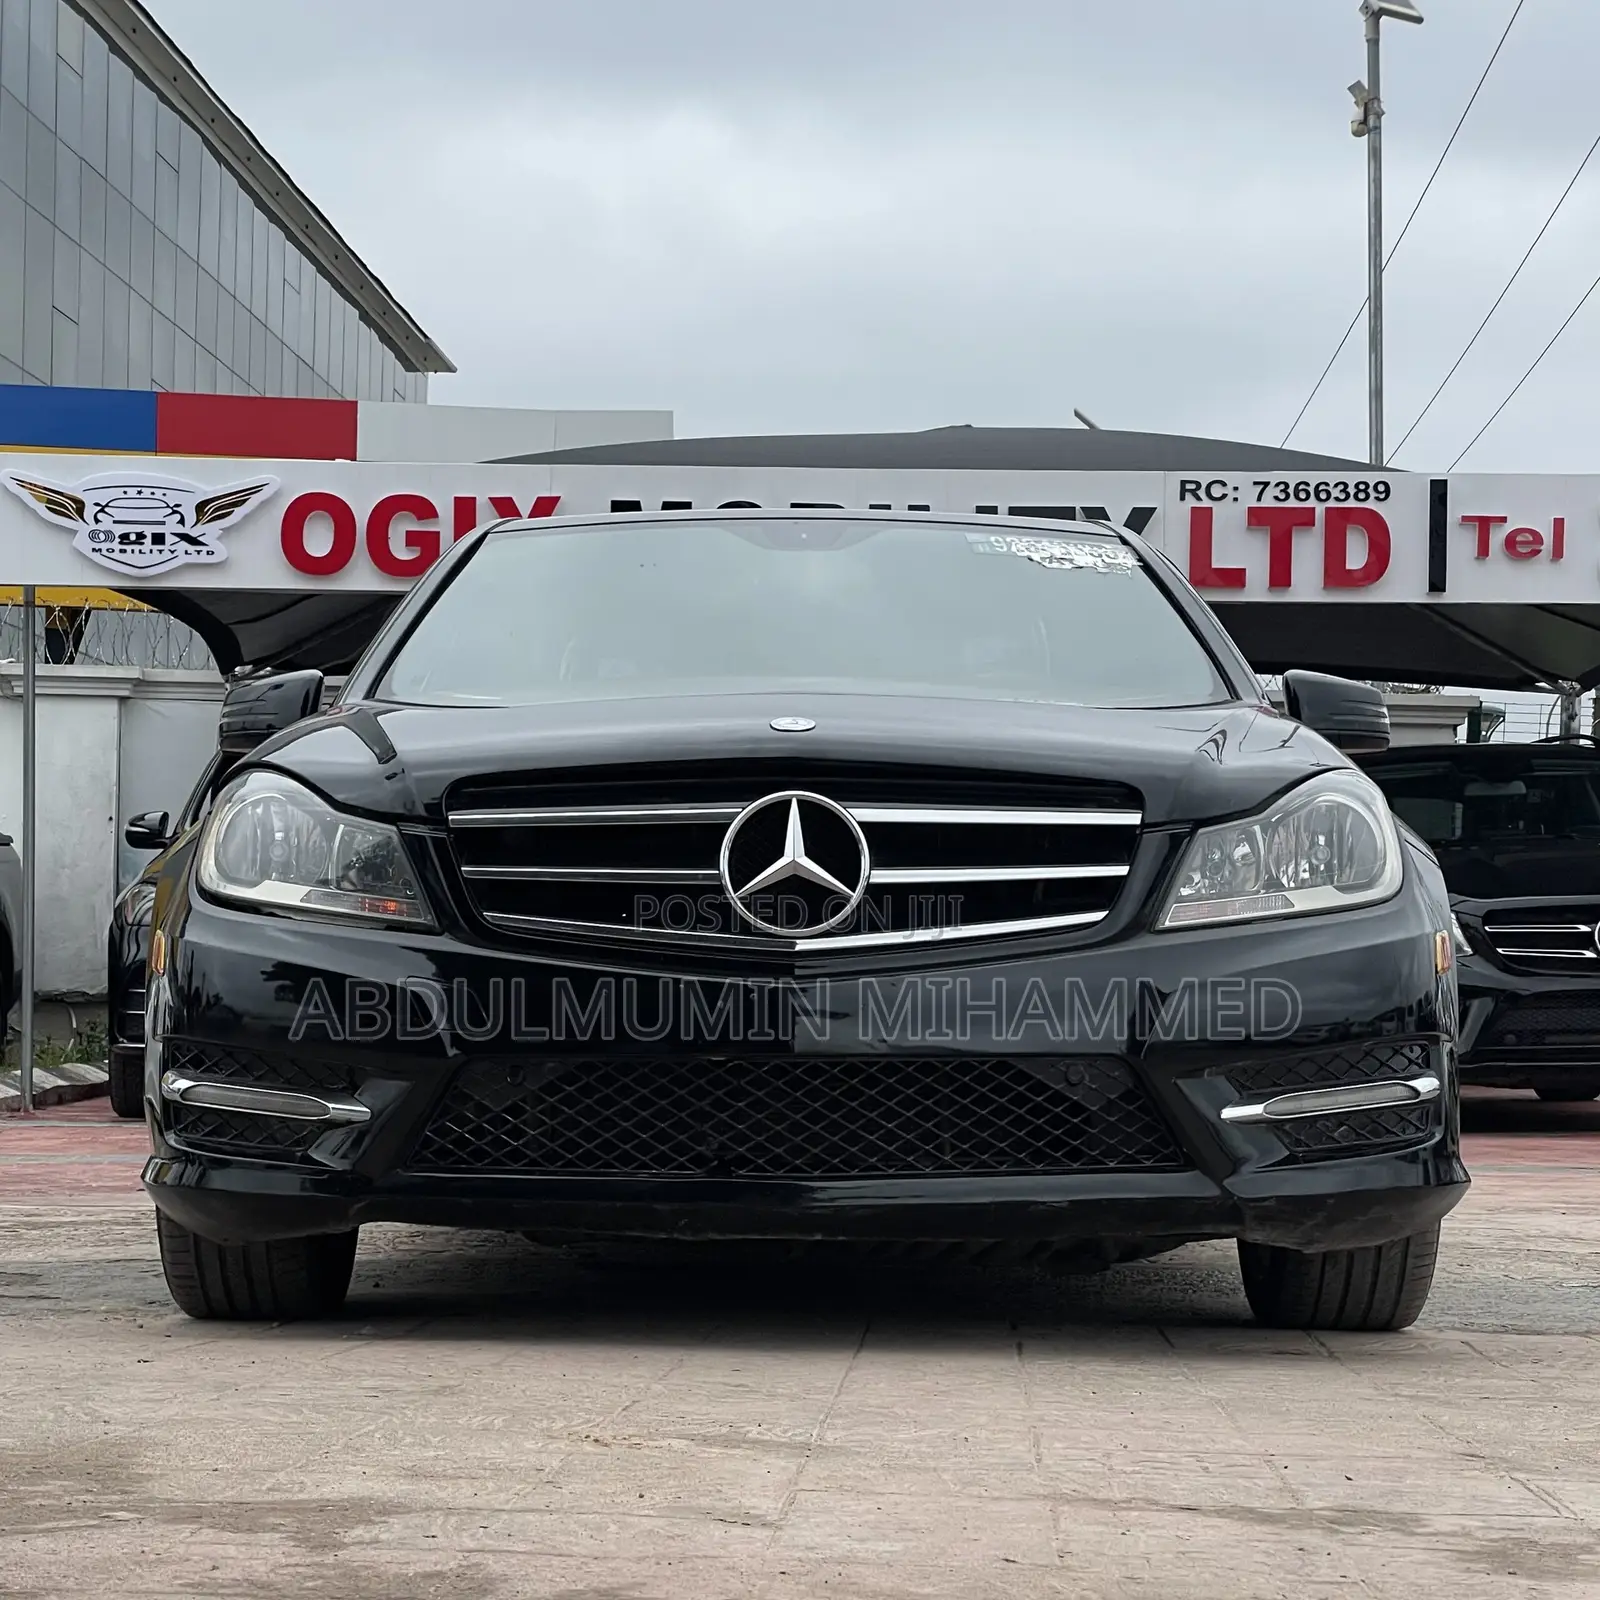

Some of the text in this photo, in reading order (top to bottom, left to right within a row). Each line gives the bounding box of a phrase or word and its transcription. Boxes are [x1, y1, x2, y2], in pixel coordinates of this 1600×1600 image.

[1178, 479, 1391, 503] RC: 7366389
[91, 547, 176, 555] MOBILITY
[1189, 506, 1392, 589] LTD
[1459, 515, 1566, 560] Tel
